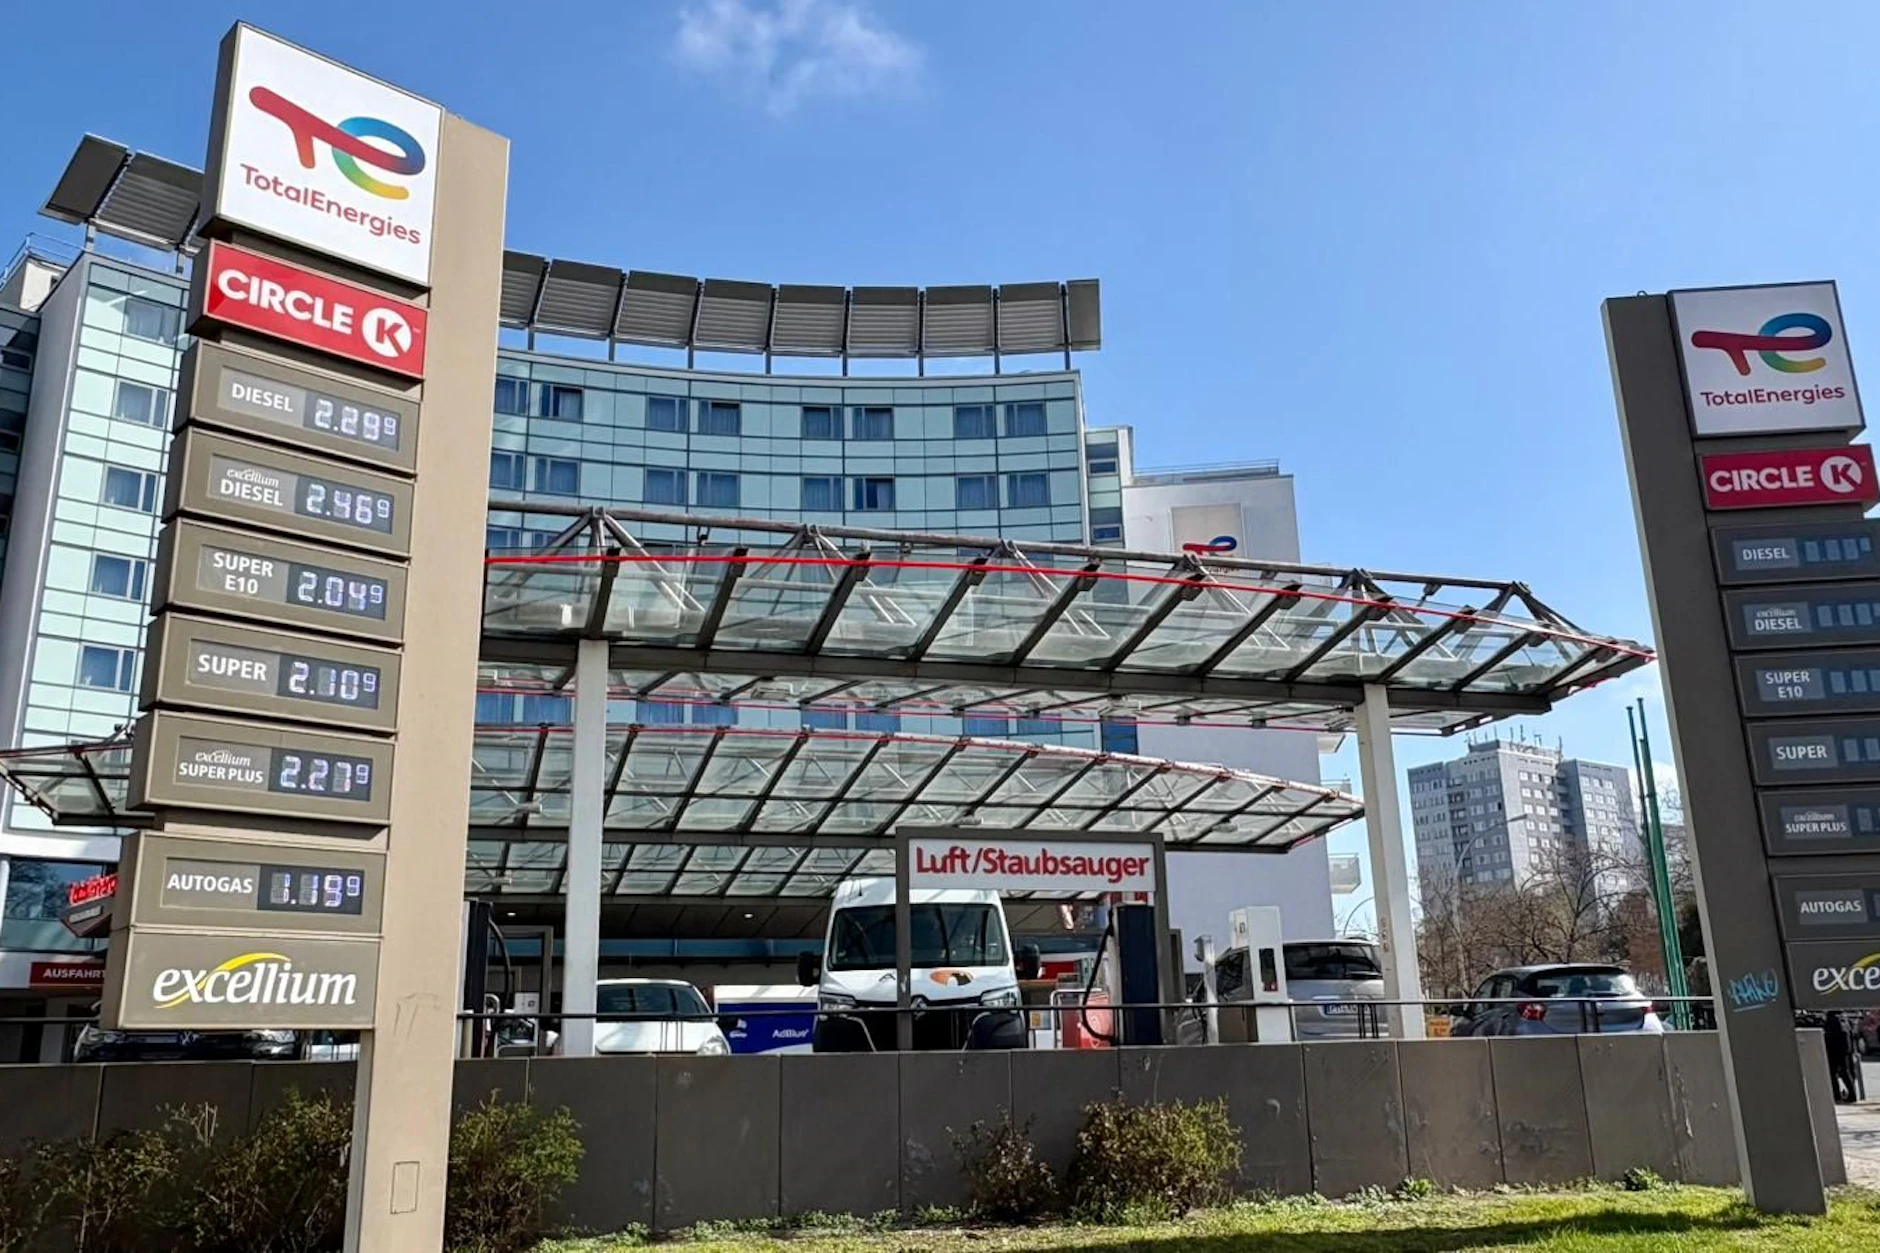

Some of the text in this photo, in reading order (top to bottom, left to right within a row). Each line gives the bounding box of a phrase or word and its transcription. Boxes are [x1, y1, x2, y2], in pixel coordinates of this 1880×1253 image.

[240, 163, 422, 245] TotalEnergies
[217, 269, 410, 356] CIRCLE K
[231, 382, 294, 413] DIESEL
[1700, 384, 1845, 407] TotalEnergies
[1709, 460, 1861, 493] CIRCLE K
[220, 478, 284, 507] DIESEL
[213, 551, 274, 578] SUPER
[1742, 547, 1791, 561] DIESEL
[224, 574, 259, 595] E10
[1755, 617, 1803, 631] DIESEL
[197, 653, 268, 682] SUPER
[1765, 671, 1810, 685] SUPER
[1777, 686, 1803, 699] E10
[1775, 745, 1828, 760] SUPER
[178, 762, 264, 784] SUPER PLUS
[1785, 821, 1848, 834] SUPER PLUS
[916, 845, 1150, 883] Luft/Staubsauger
[167, 872, 253, 895] AUTOGAS
[1800, 900, 1862, 914] AUTOGAS
[152, 956, 357, 1005] excellium
